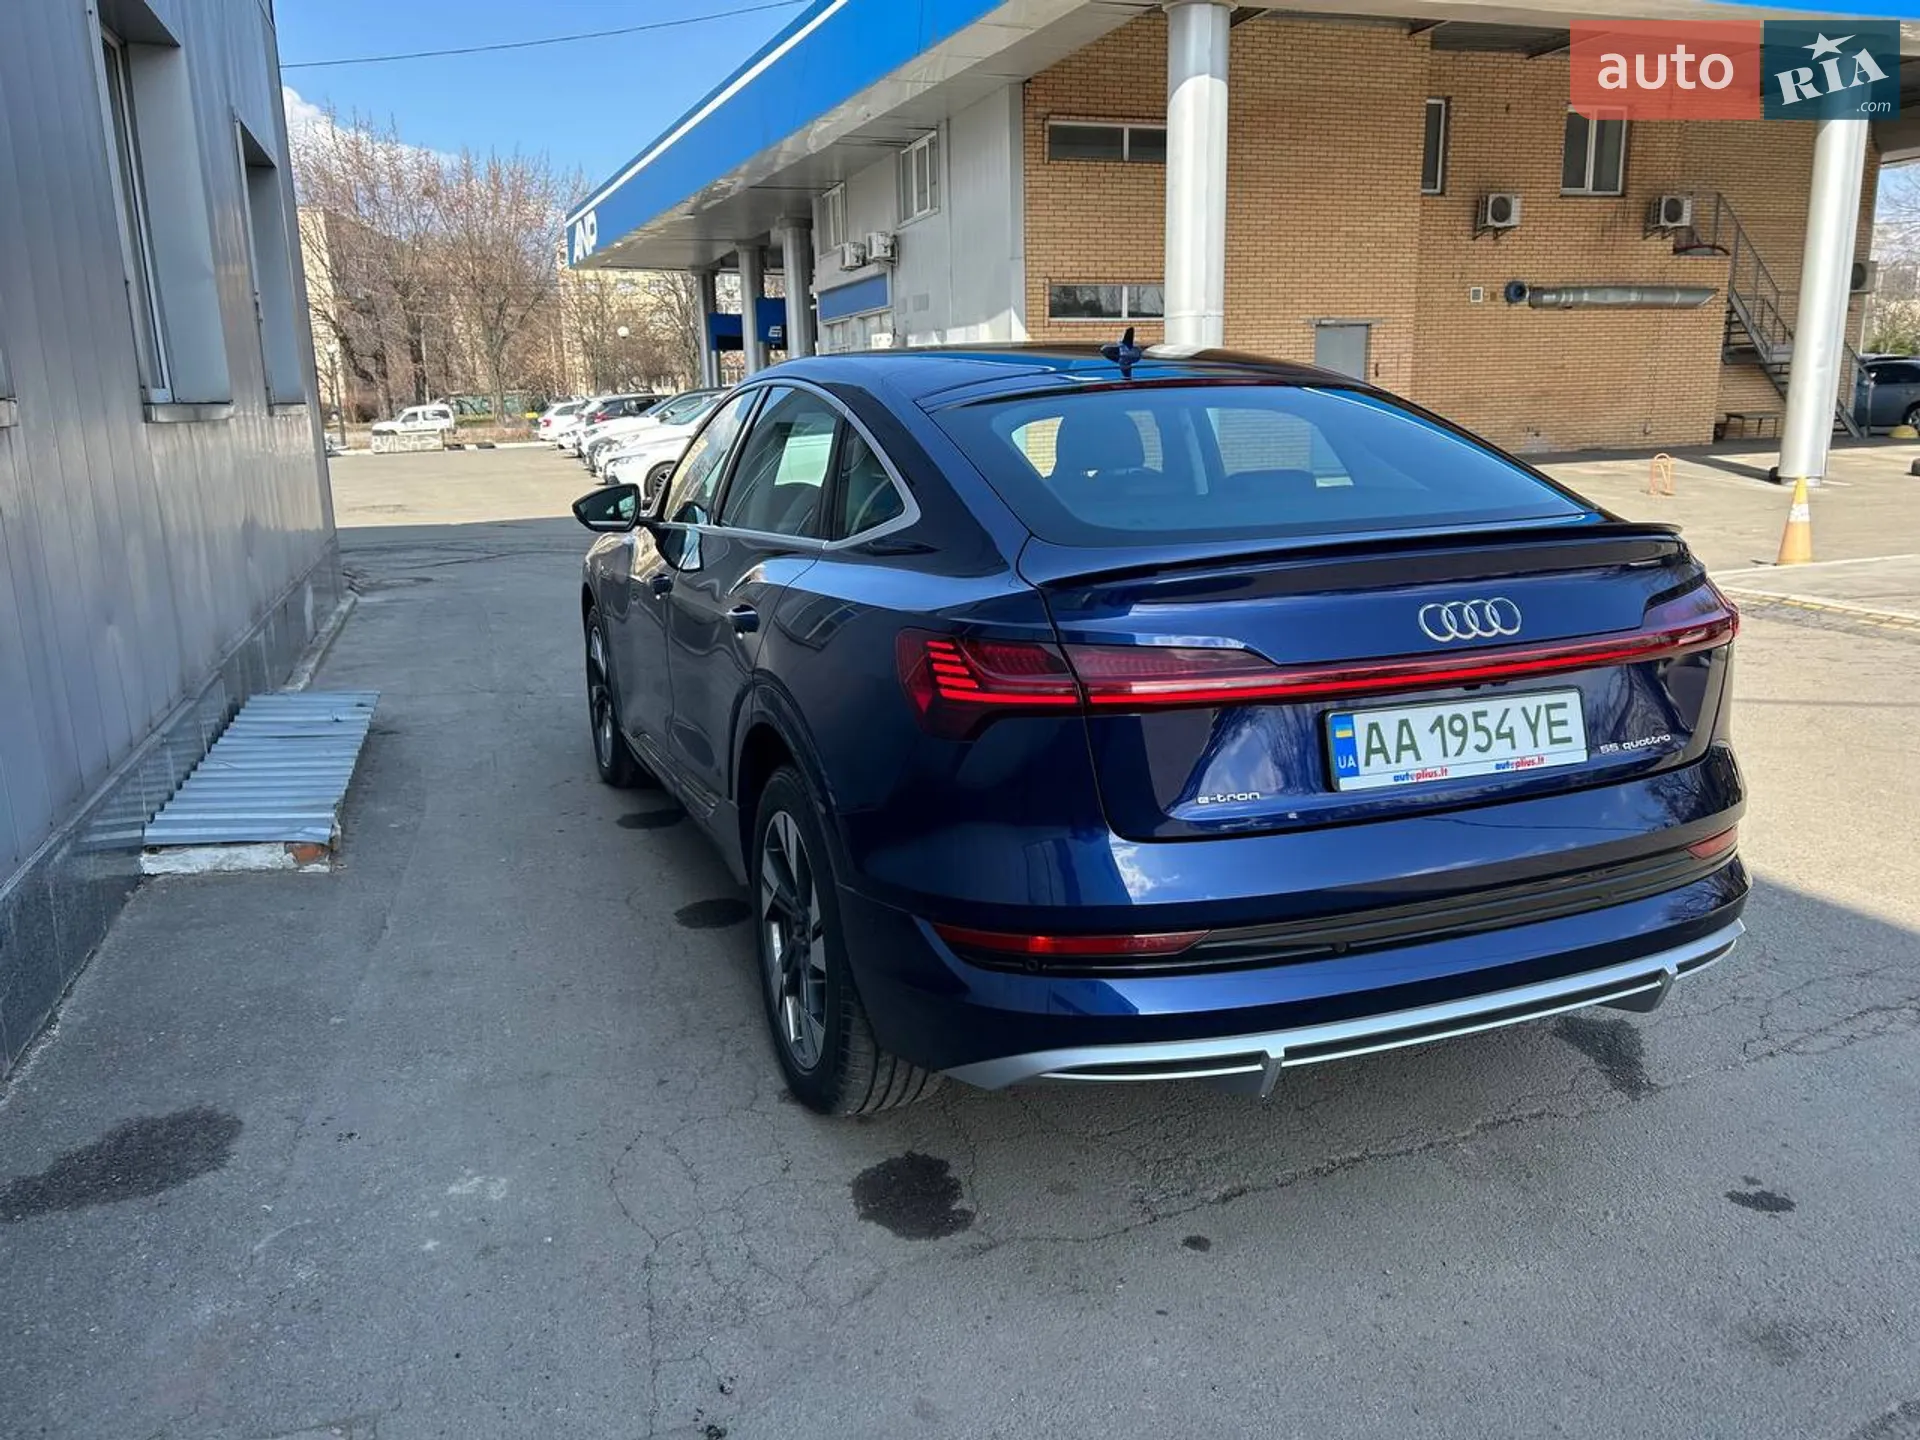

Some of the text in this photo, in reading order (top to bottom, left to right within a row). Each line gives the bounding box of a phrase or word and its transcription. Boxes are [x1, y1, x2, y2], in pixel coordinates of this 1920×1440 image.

[1364, 702, 1573, 767] AA 1954 YE
[1600, 734, 1671, 754] 55 quattro
[1337, 755, 1357, 769] UA
[1393, 766, 1448, 783] autoplius.lt
[1197, 791, 1260, 804] e-tron
